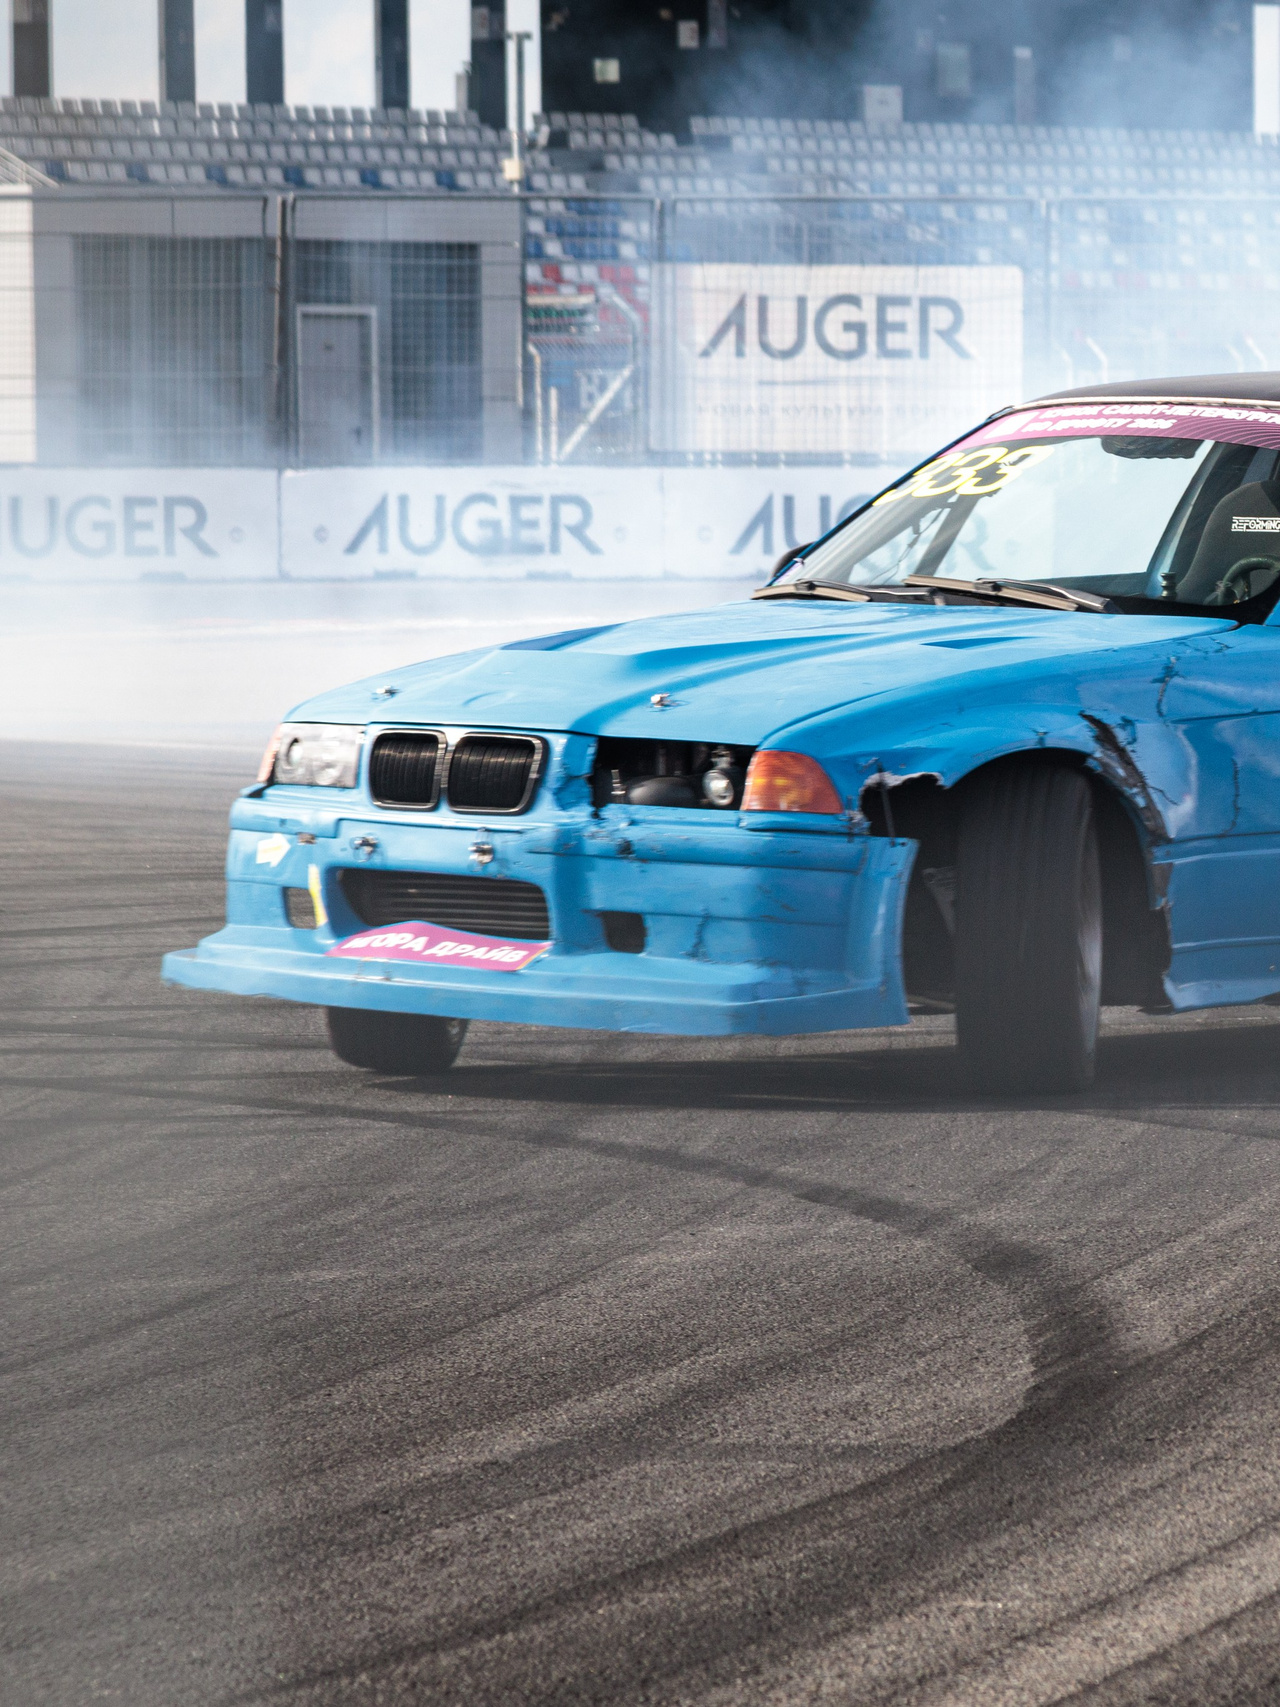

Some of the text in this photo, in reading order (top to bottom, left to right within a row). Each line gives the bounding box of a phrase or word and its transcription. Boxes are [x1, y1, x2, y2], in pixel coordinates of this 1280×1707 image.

[698, 292, 974, 360] AUGER
[0, 494, 220, 558] UGER
[343, 492, 603, 556] AUGER
[423, 942, 530, 963] ДРАЙВ
